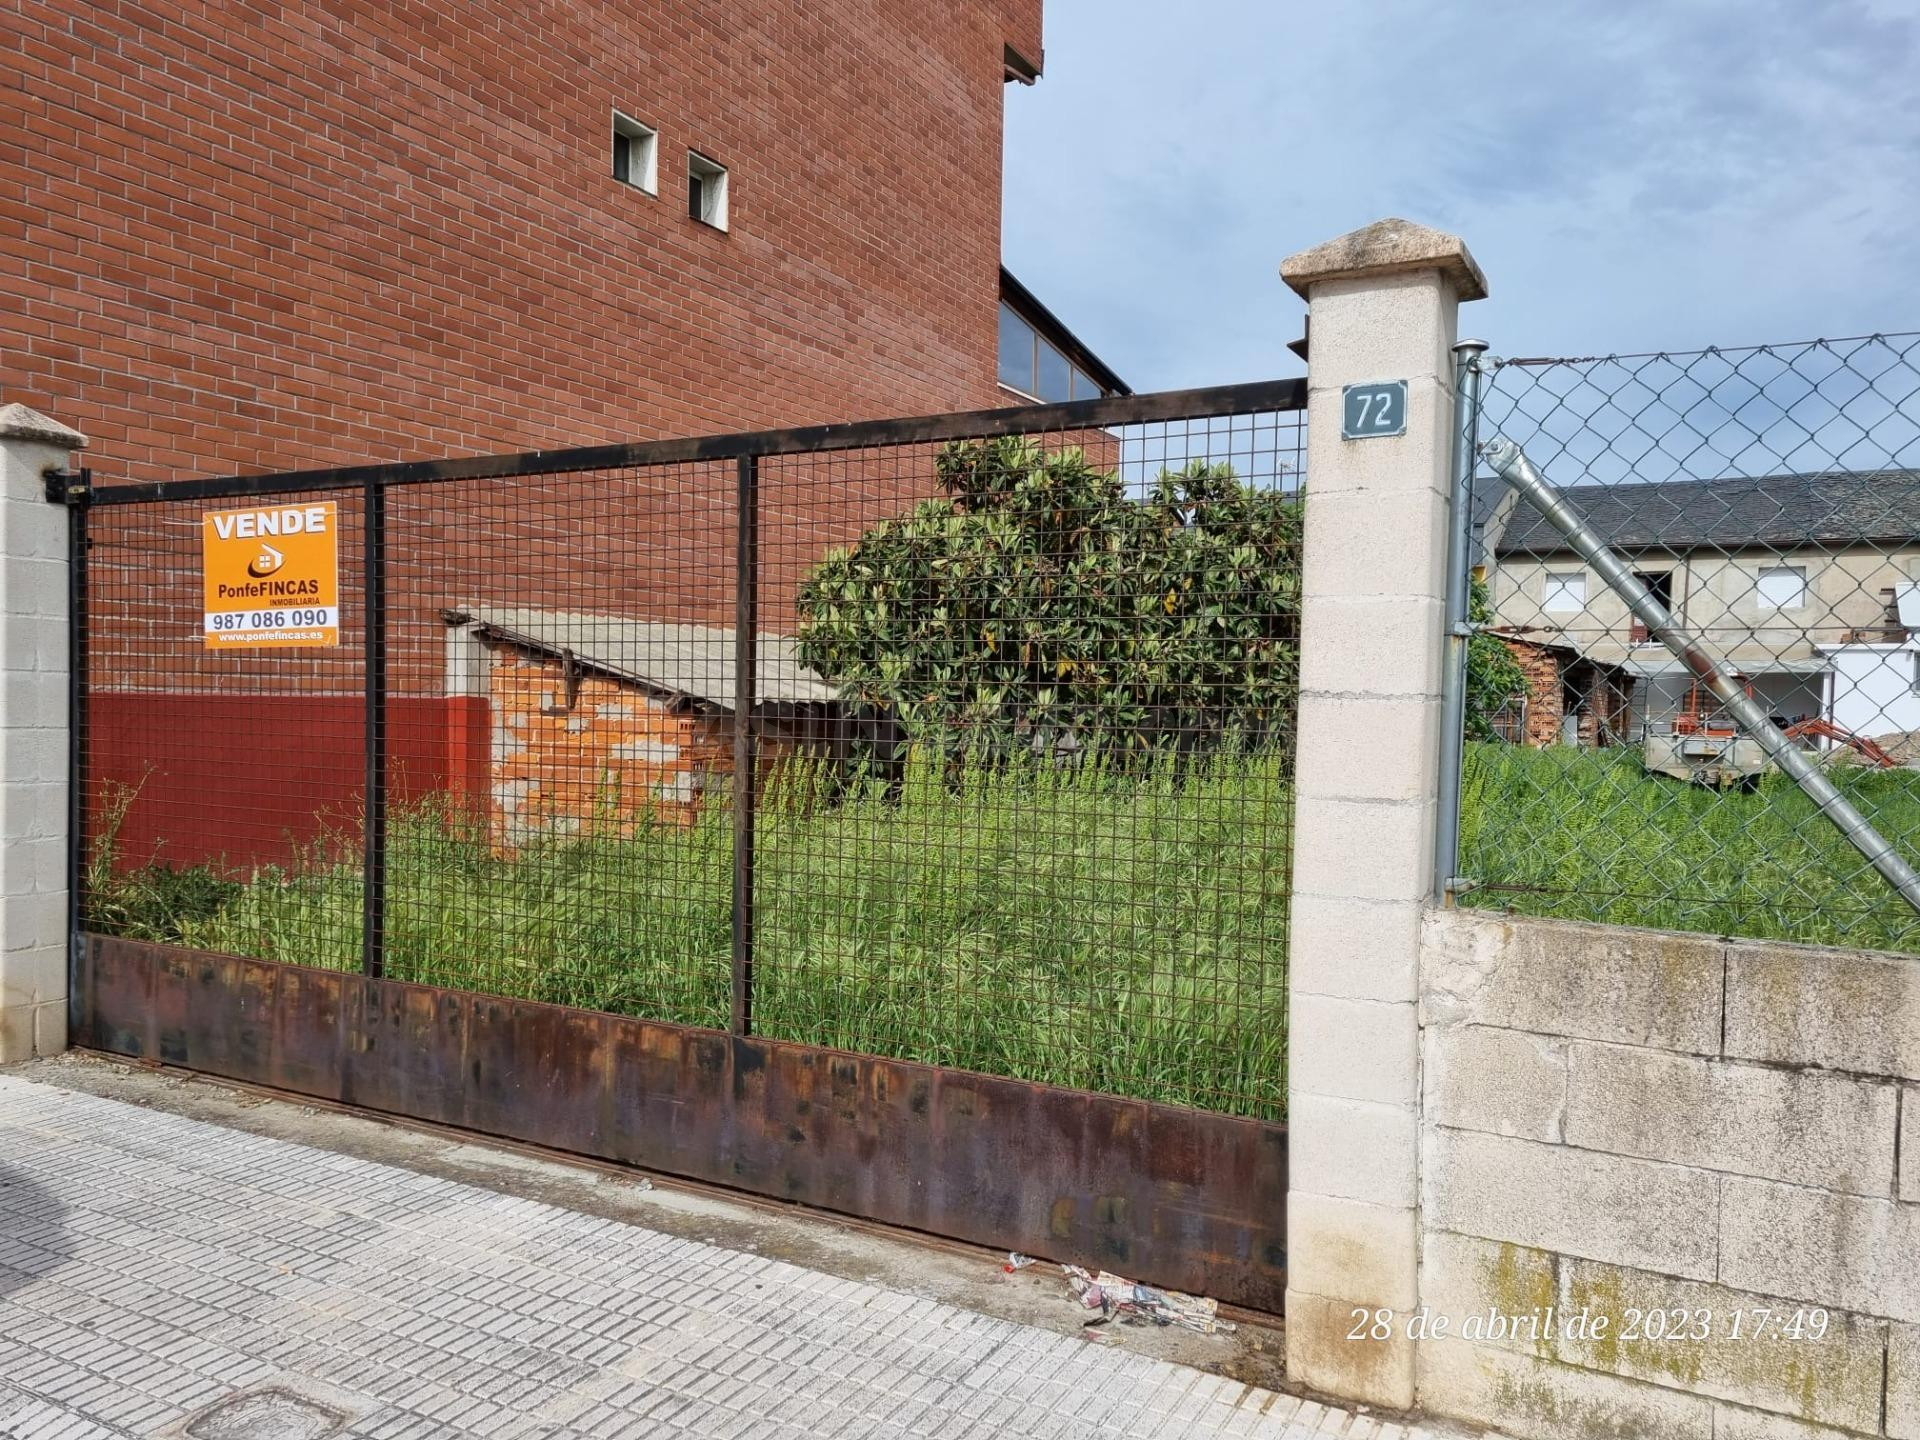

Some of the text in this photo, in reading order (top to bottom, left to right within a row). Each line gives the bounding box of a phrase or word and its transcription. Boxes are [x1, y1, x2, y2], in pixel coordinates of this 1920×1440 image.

[1356, 392, 1392, 428] 72
[213, 507, 326, 540] VENDE
[218, 579, 319, 598] PonfeFINCAS
[269, 598, 320, 606] INMOBILIARIA
[213, 609, 327, 630] 987 086 090
[218, 630, 323, 643] www.ponfefincas.es
